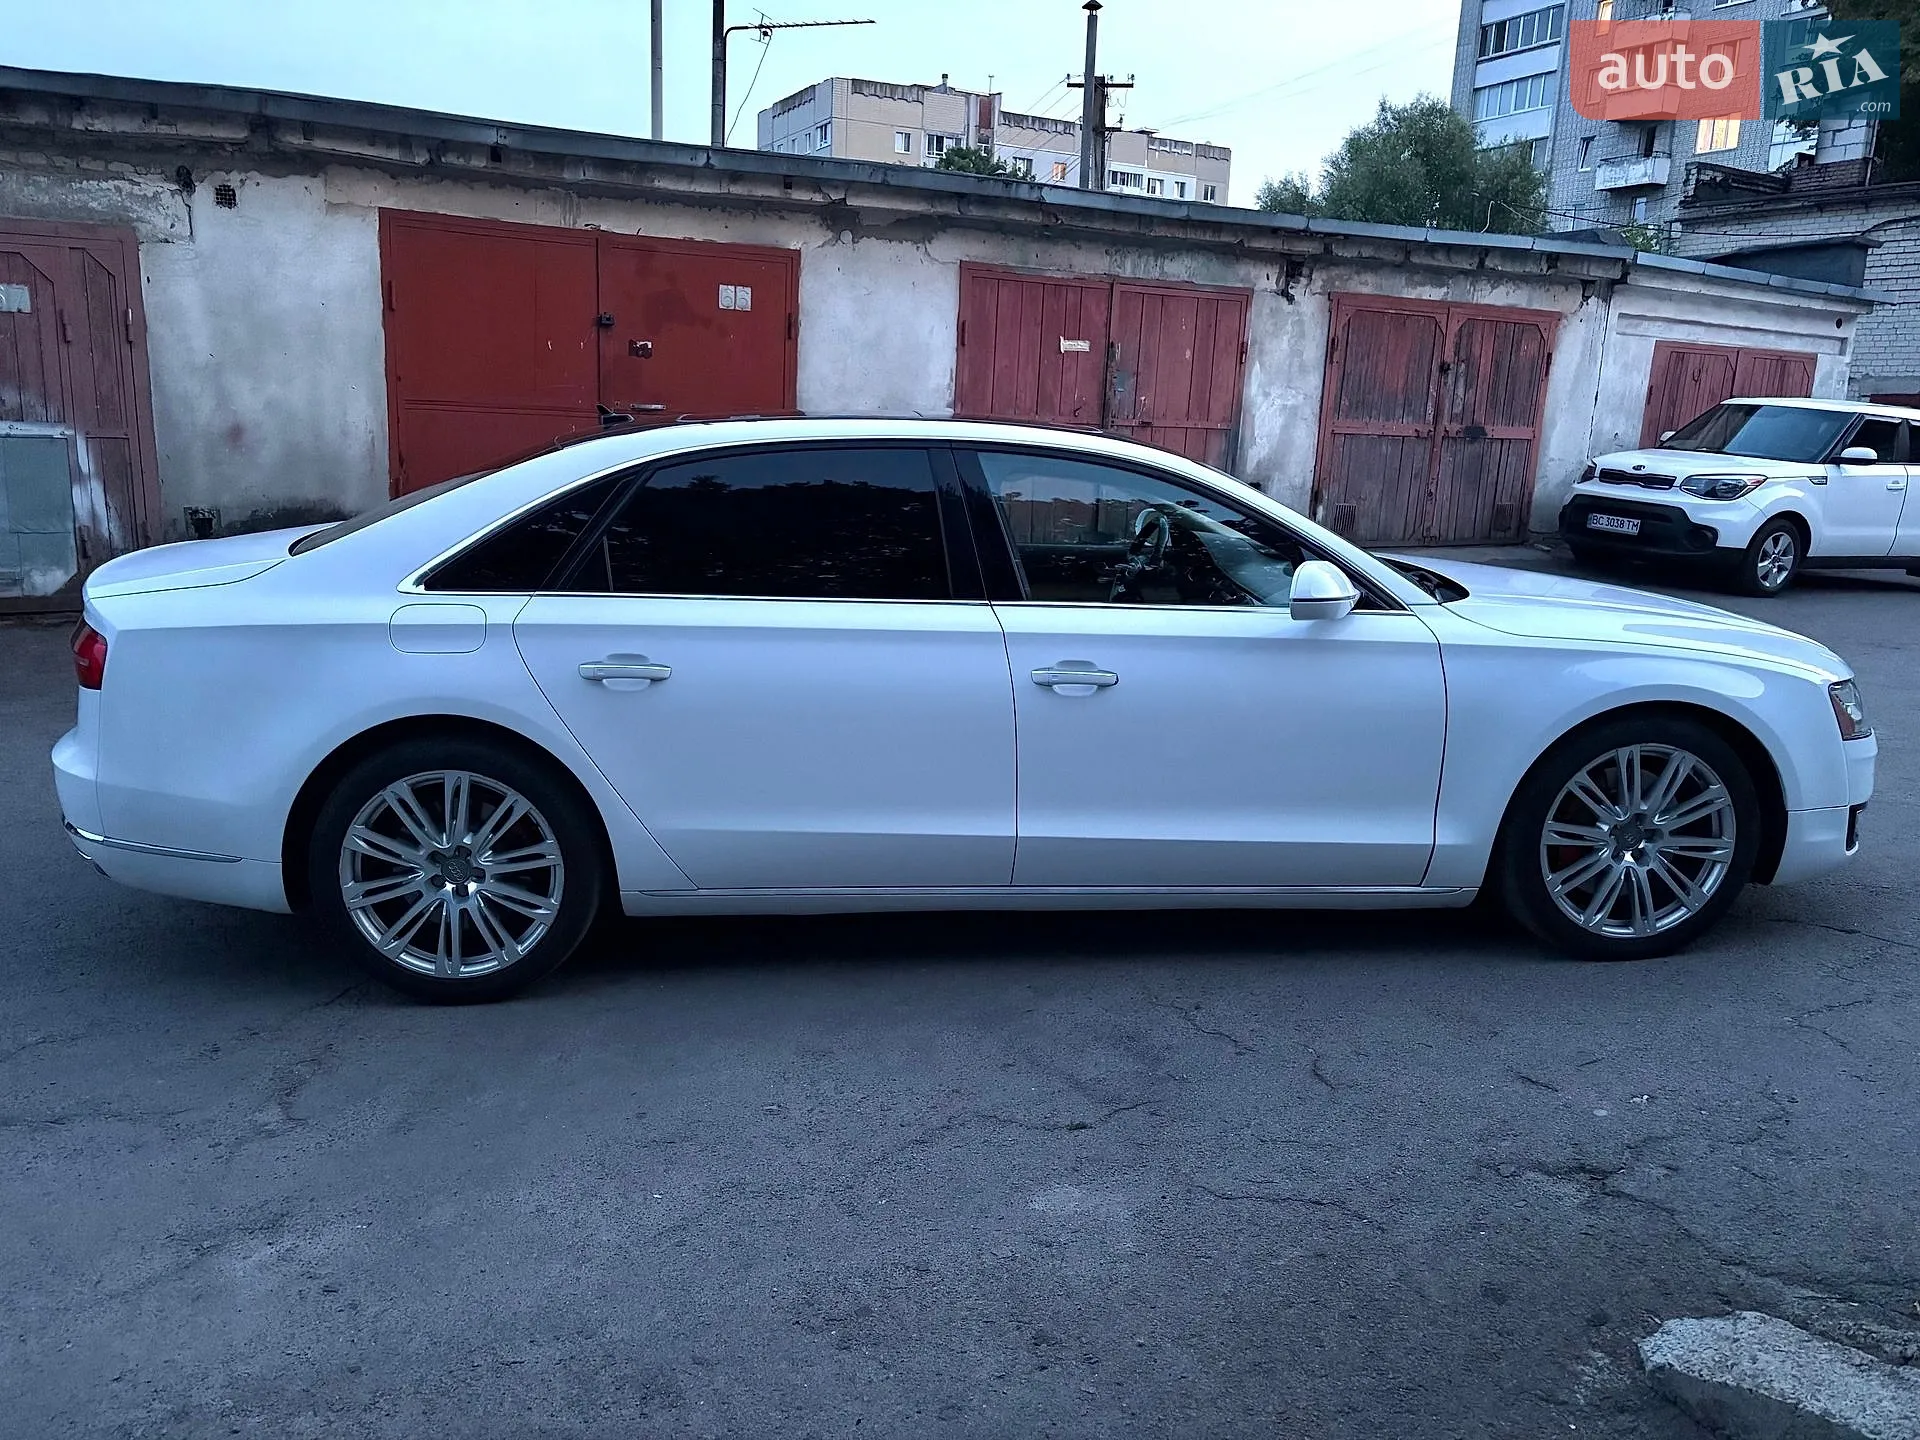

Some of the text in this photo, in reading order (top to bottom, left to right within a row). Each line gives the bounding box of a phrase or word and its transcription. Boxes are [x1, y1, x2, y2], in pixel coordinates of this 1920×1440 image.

[1592, 515, 1639, 531] BC 3038 TM
